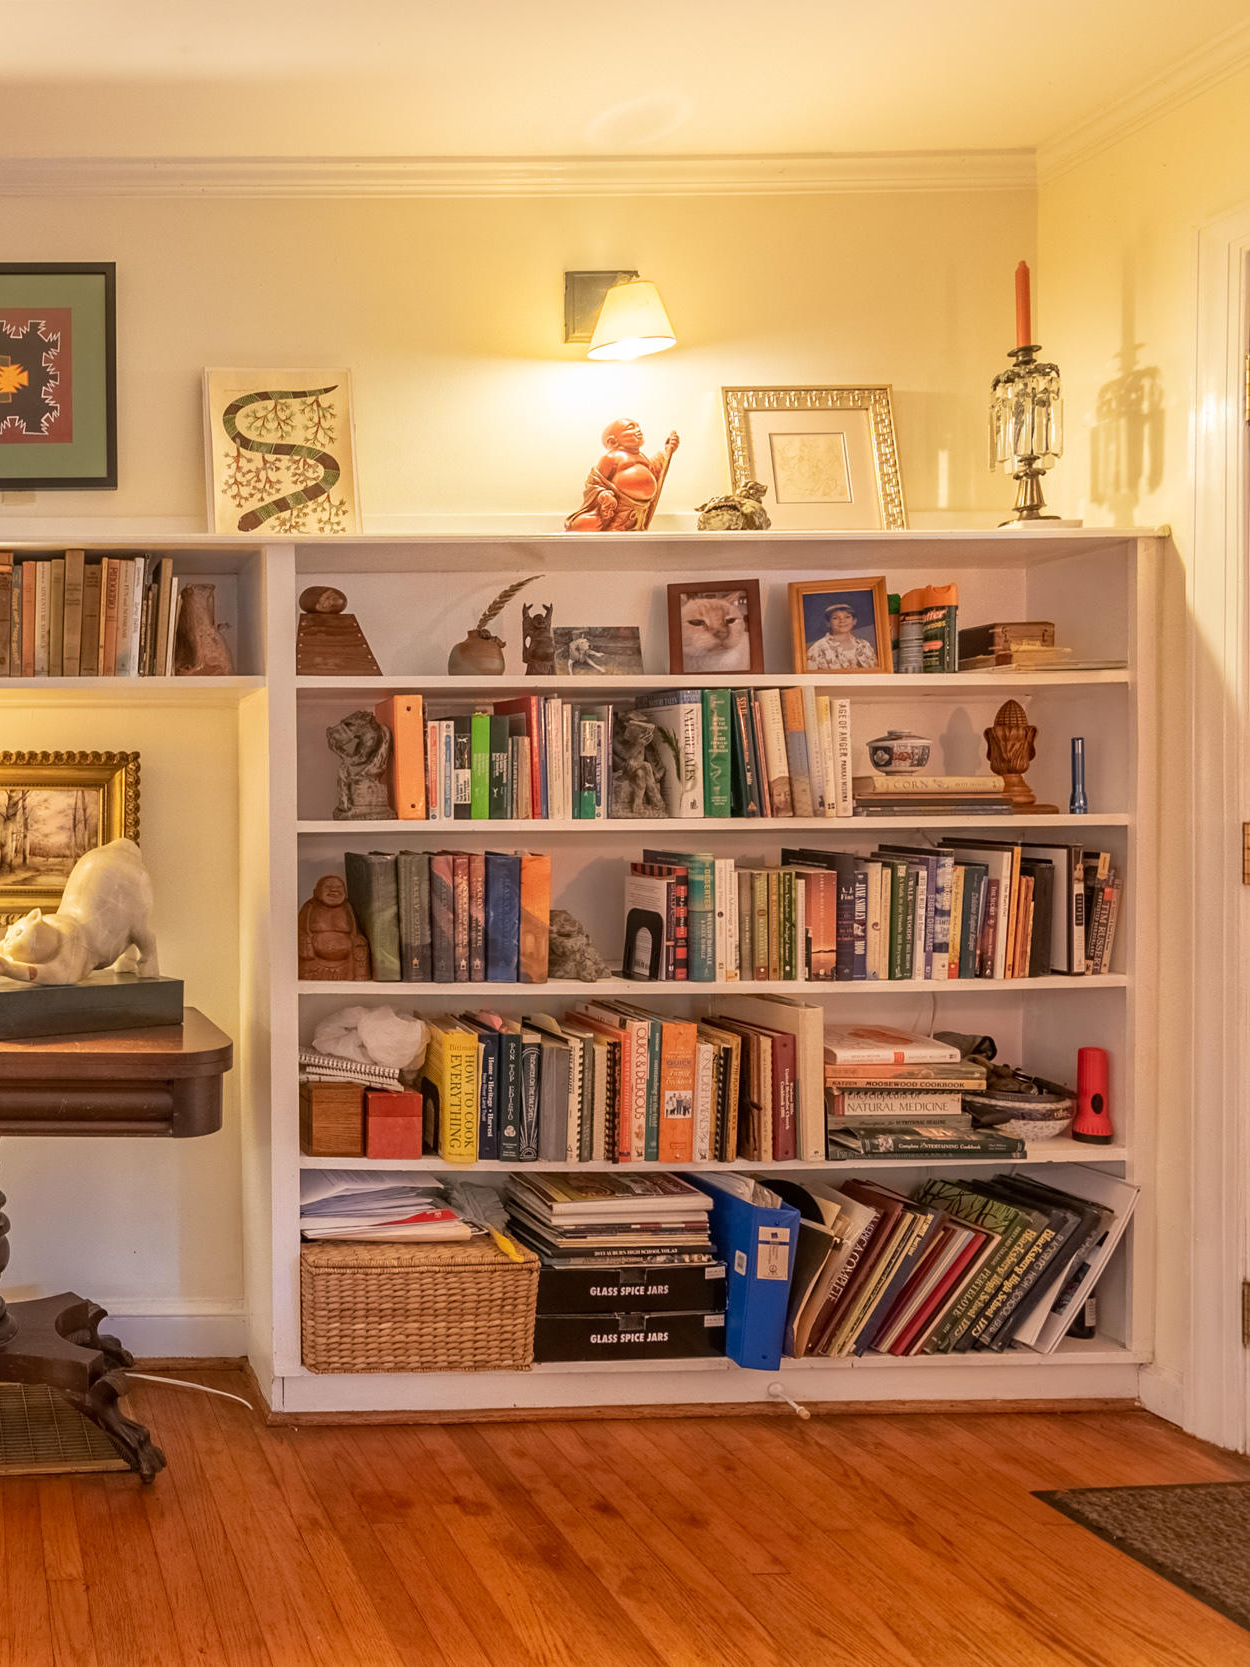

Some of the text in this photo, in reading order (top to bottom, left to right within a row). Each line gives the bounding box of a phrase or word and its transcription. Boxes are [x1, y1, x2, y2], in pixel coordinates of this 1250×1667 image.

[838, 704, 847, 719] AGE
[839, 720, 847, 730] OF
[684, 708, 695, 781] NATURE TALES
[839, 732, 848, 758] ANGER
[854, 883, 867, 955] JANE SMILEY MOO
[926, 894, 935, 952] EIGER DREAMS
[1099, 902, 1110, 923] TIM
[1094, 927, 1108, 973] RUSSERT
[634, 1027, 647, 1119] QUICK & DELICIOUS
[701, 1050, 713, 1073] ONE
[449, 1054, 462, 1148] EVERYTHING
[463, 1054, 475, 1148] HOW TO COOK
[487, 1081, 495, 1107] Heritage
[508, 1085, 516, 1120] EDISTO
[846, 1102, 949, 1112] NATURAL MEDICINE
[699, 1100, 711, 1130] MEALS
[828, 1212, 881, 1305] AMERICA COMPLETE
[968, 1228, 1038, 1319] Blacksburg High School
[985, 1228, 1056, 1319] Blacksburg High School
[590, 1285, 669, 1296] GLASS SPICE JARS
[952, 1268, 992, 1317] PERTELOTE
[1021, 1272, 1037, 1289] HIGH
[1003, 1290, 1023, 1318] SCHOOL
[590, 1332, 669, 1343] GLASS SPICE JARS
